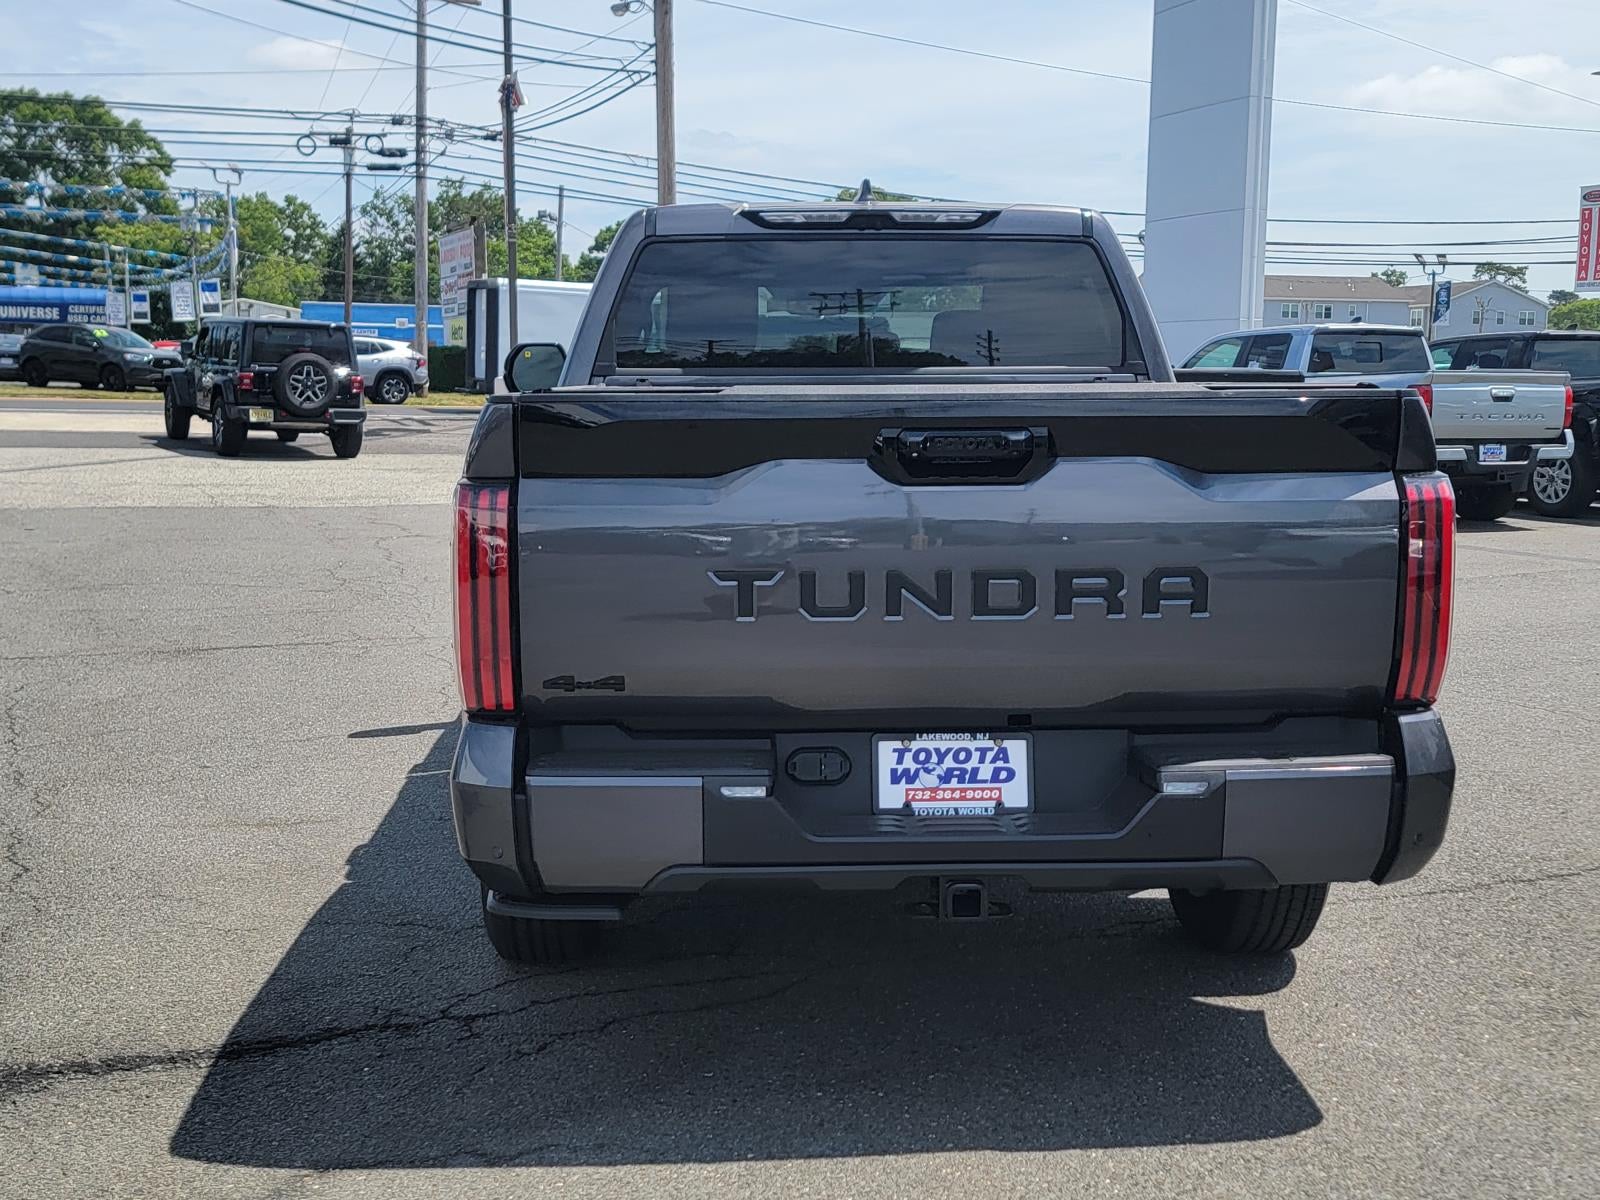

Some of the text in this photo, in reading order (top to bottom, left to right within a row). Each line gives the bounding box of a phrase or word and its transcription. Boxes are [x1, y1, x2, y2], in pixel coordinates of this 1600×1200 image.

[1579, 210, 1590, 279] TOYOTA
[0, 305, 60, 320] UNIVERSE
[68, 305, 107, 314] CERTIFIE
[67, 314, 89, 323] USED
[1456, 413, 1545, 421] TACOMA
[707, 566, 1210, 621] TUNDRA
[916, 733, 989, 742] LAKEWOOD, NJ
[892, 746, 1010, 766] TOYOTA
[890, 764, 1016, 787] WORLD
[907, 789, 1000, 800] 732-364-9000
[914, 807, 995, 816] TOYOTA WORLD
